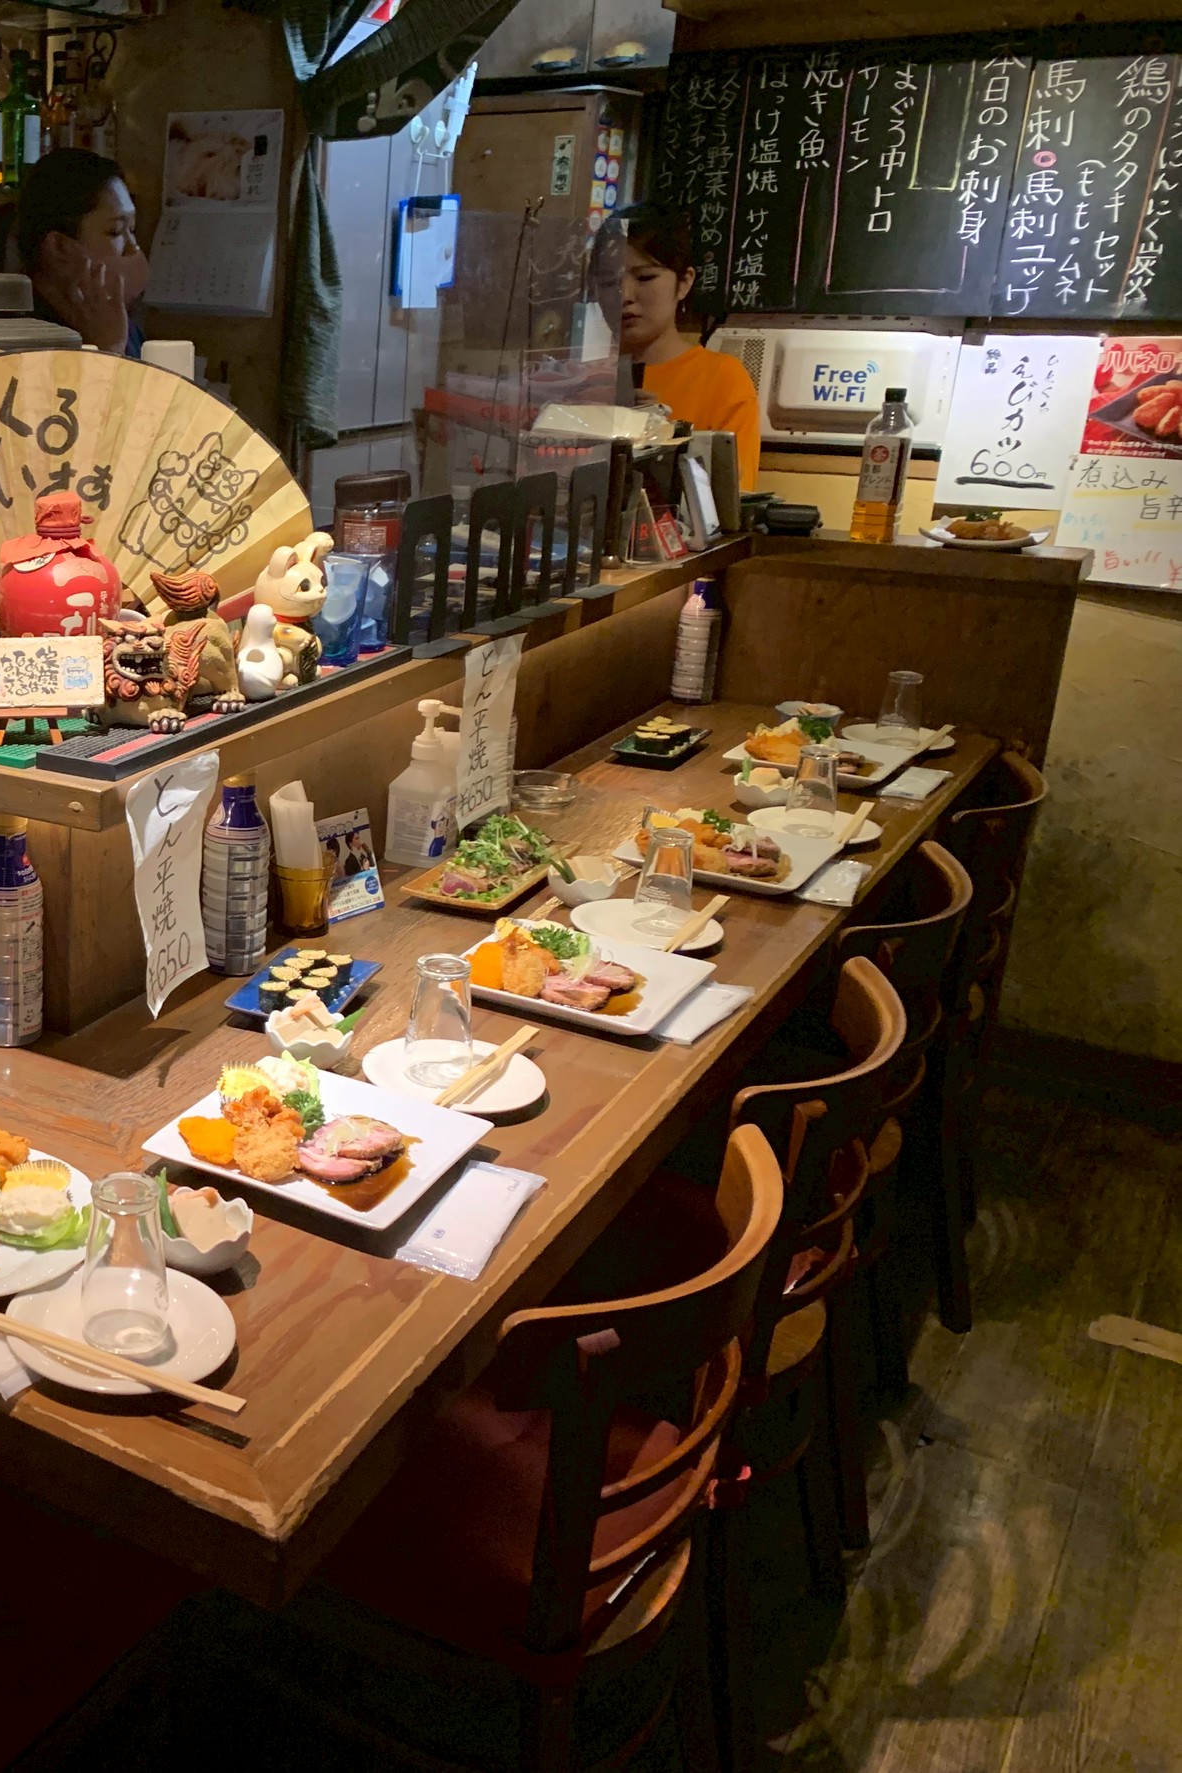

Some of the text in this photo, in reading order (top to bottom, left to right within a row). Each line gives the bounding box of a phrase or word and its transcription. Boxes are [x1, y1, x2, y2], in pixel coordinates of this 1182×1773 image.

[847, 63, 886, 174] サーモン
[957, 45, 1026, 245] 本日のお刺身
[812, 384, 867, 403] Wi-Fi
[813, 364, 868, 384] Free
[995, 355, 1038, 458] えびカツ
[1077, 458, 1168, 490] 煮込み
[468, 648, 494, 778] とん平焼
[151, 773, 183, 943] とん平焼
[148, 931, 192, 999] ¥650
